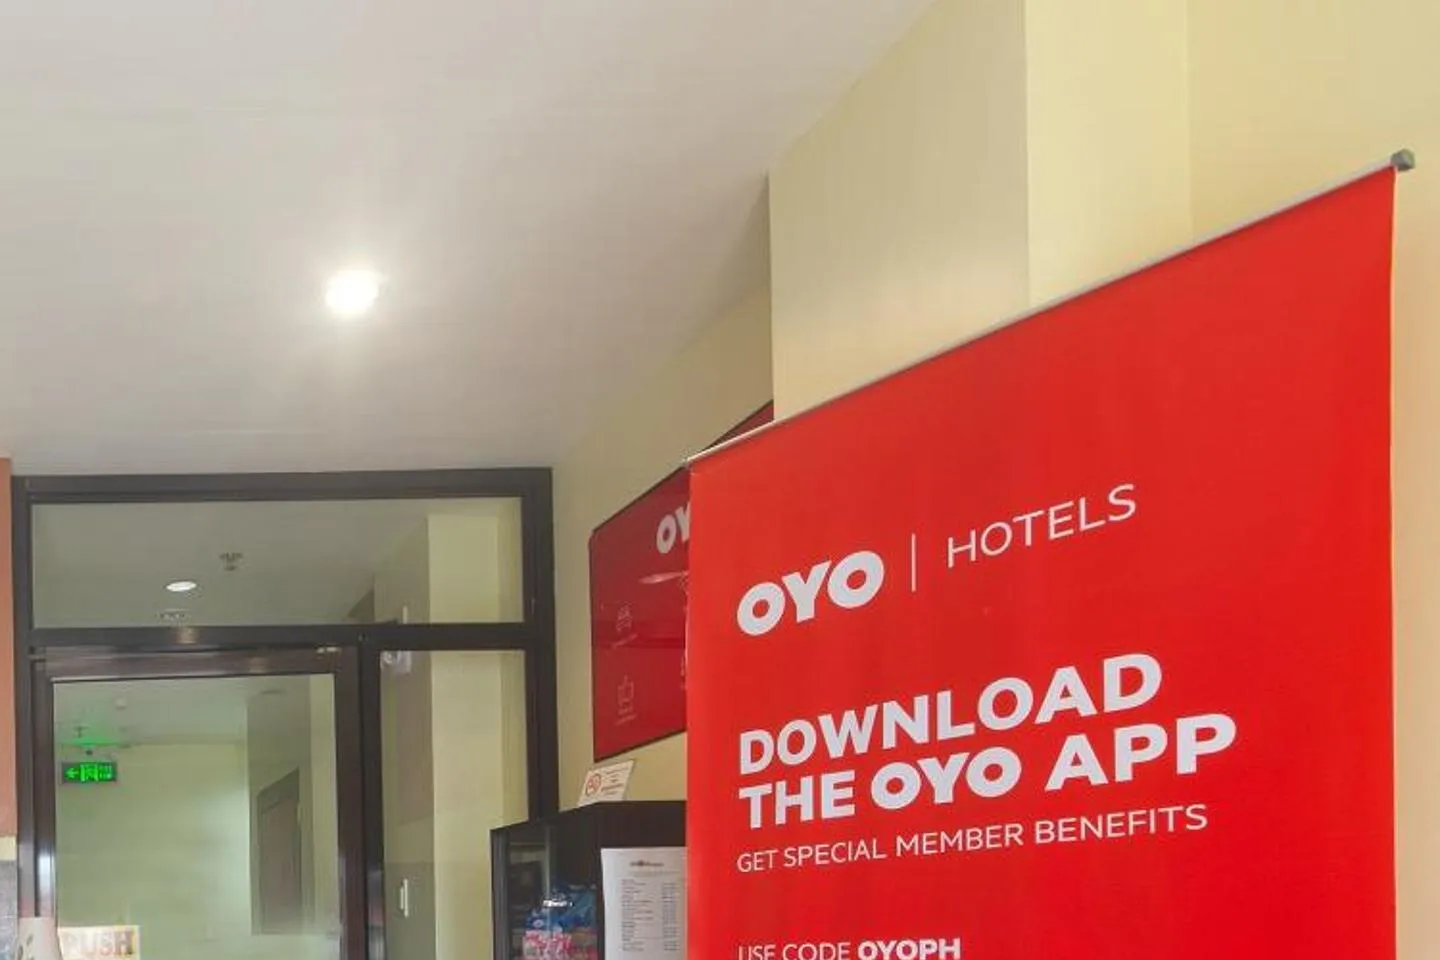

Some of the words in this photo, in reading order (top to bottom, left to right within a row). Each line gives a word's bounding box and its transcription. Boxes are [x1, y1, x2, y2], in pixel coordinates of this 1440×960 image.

[737, 551, 884, 635] OYO
[948, 484, 1136, 567] HOTELS
[739, 653, 1163, 775] DOWNLOAD
[739, 770, 855, 829] THE
[871, 746, 1022, 810] OYO
[1044, 713, 1238, 791] APP
[737, 850, 778, 873] GET
[784, 838, 888, 867] SPECIAL
[896, 821, 1024, 857] MEMBER
[1035, 803, 1208, 845] BENEFITS
[62, 929, 134, 957] PUSH
